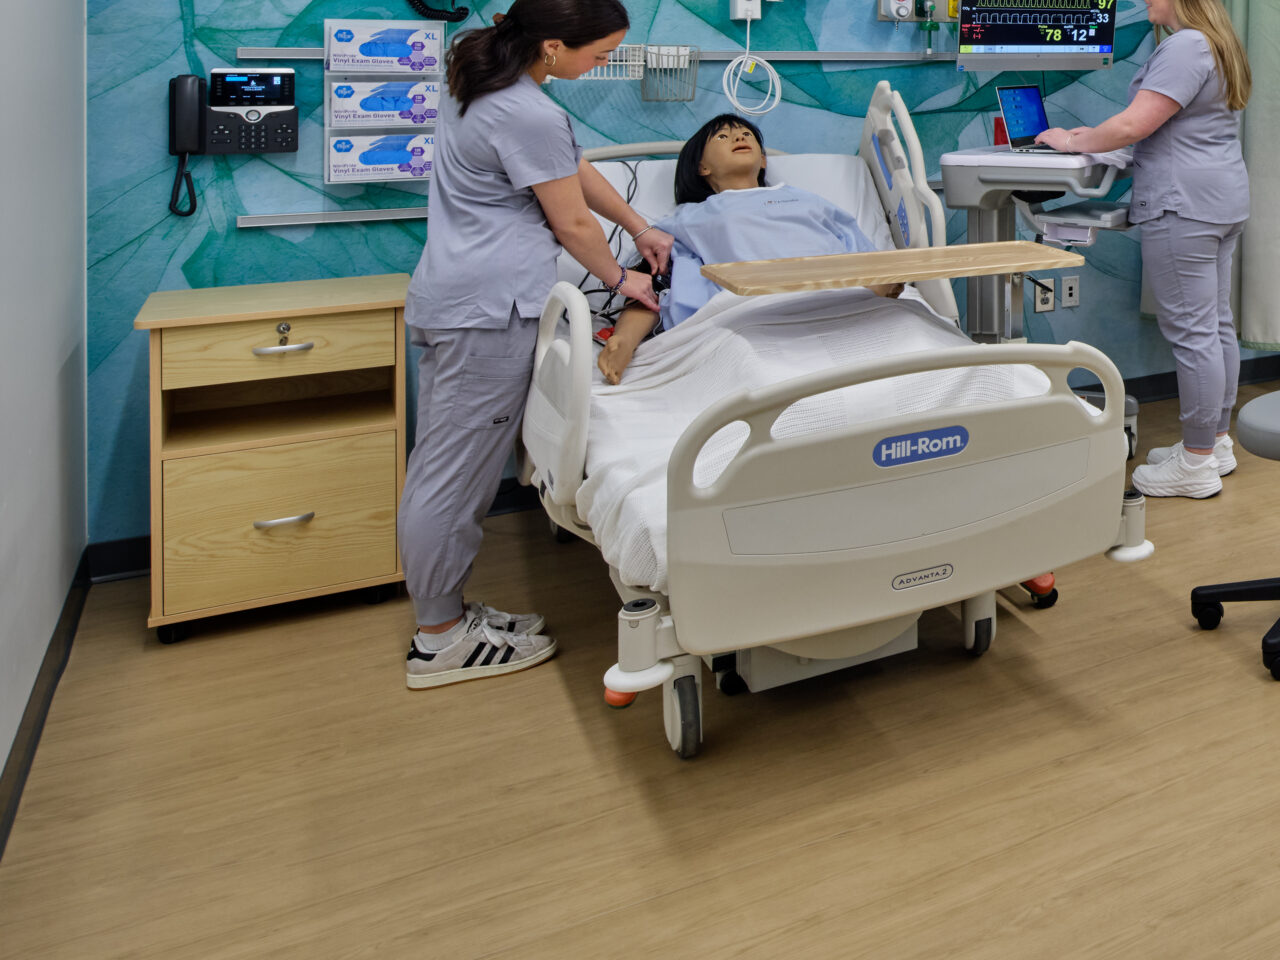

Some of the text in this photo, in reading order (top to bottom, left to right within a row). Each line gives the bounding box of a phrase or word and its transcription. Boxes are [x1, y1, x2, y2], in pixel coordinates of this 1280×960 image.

[1096, 13, 1109, 23] 33
[424, 32, 437, 40] XL
[1045, 29, 1062, 41] 78
[1071, 29, 1087, 41] 12
[881, 435, 962, 461] Hill-Rom
[898, 571, 940, 585] ADVANTA
